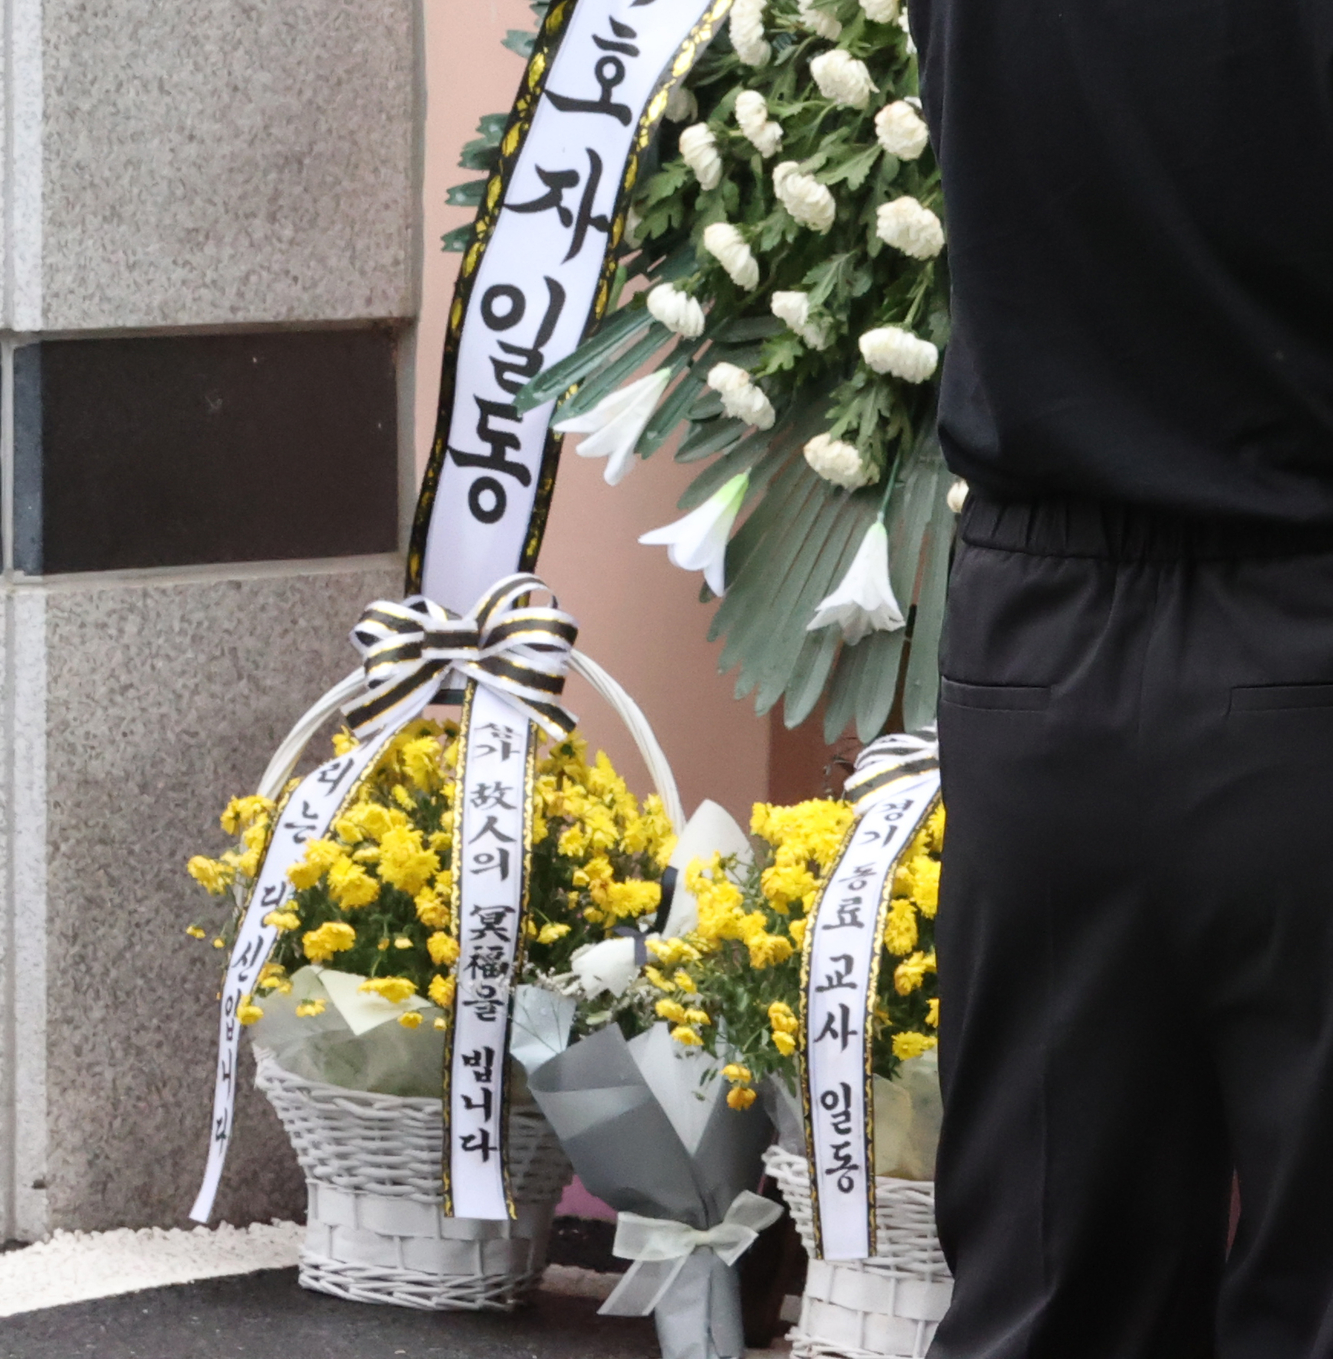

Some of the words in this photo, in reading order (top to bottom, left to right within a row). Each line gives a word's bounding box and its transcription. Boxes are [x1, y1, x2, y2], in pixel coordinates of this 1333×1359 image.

[448, 275, 567, 524] 일동
[474, 722, 521, 762] 삼가
[283, 743, 367, 844] 리는
[468, 781, 518, 882] 故人의
[858, 799, 915, 848] 경기
[821, 862, 878, 931] 동료
[463, 904, 516, 1022] 冥福을
[813, 954, 858, 1052] 교사
[215, 880, 288, 1156] 당신입니다
[459, 1046, 498, 1163] 빕니다
[820, 1082, 859, 1194] 일동
